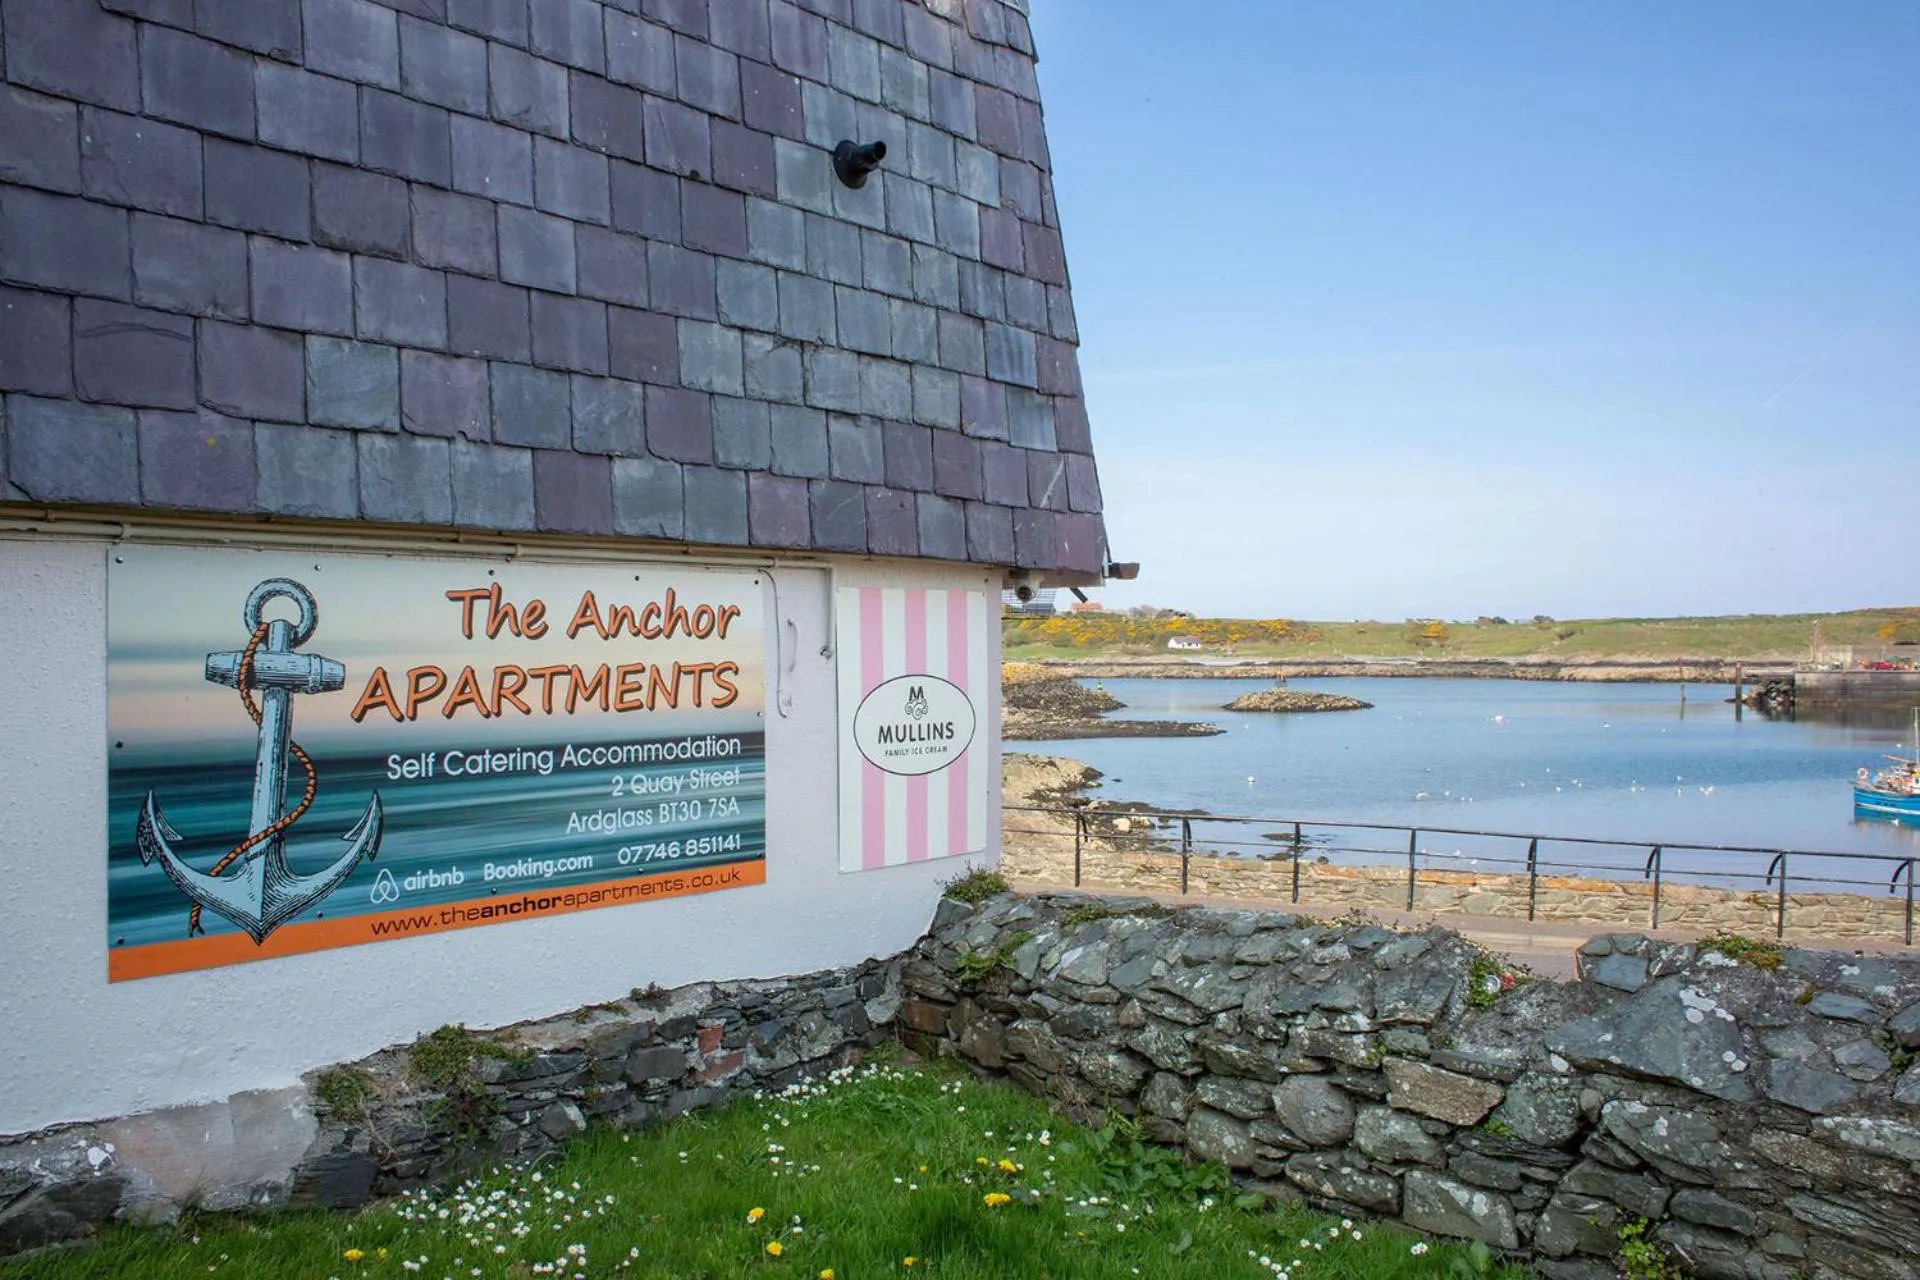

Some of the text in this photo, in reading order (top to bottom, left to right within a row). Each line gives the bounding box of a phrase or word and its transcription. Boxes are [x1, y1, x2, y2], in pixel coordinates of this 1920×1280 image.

[446, 582, 741, 641] The Anchor
[350, 661, 739, 722] APARTMENTS
[878, 721, 955, 744] MULLINS
[387, 735, 742, 780] Self Catering Accommodation
[884, 745, 948, 757] FAMILY ICE CREAM
[611, 766, 741, 799] 2 Quay Street
[566, 796, 740, 836] Ardglass BT30 7SA
[617, 834, 742, 866] 07746 851141
[404, 866, 465, 892] airbnb
[483, 853, 594, 881] Booking.com
[371, 868, 741, 936] www.theanchorapartments.co.uk
